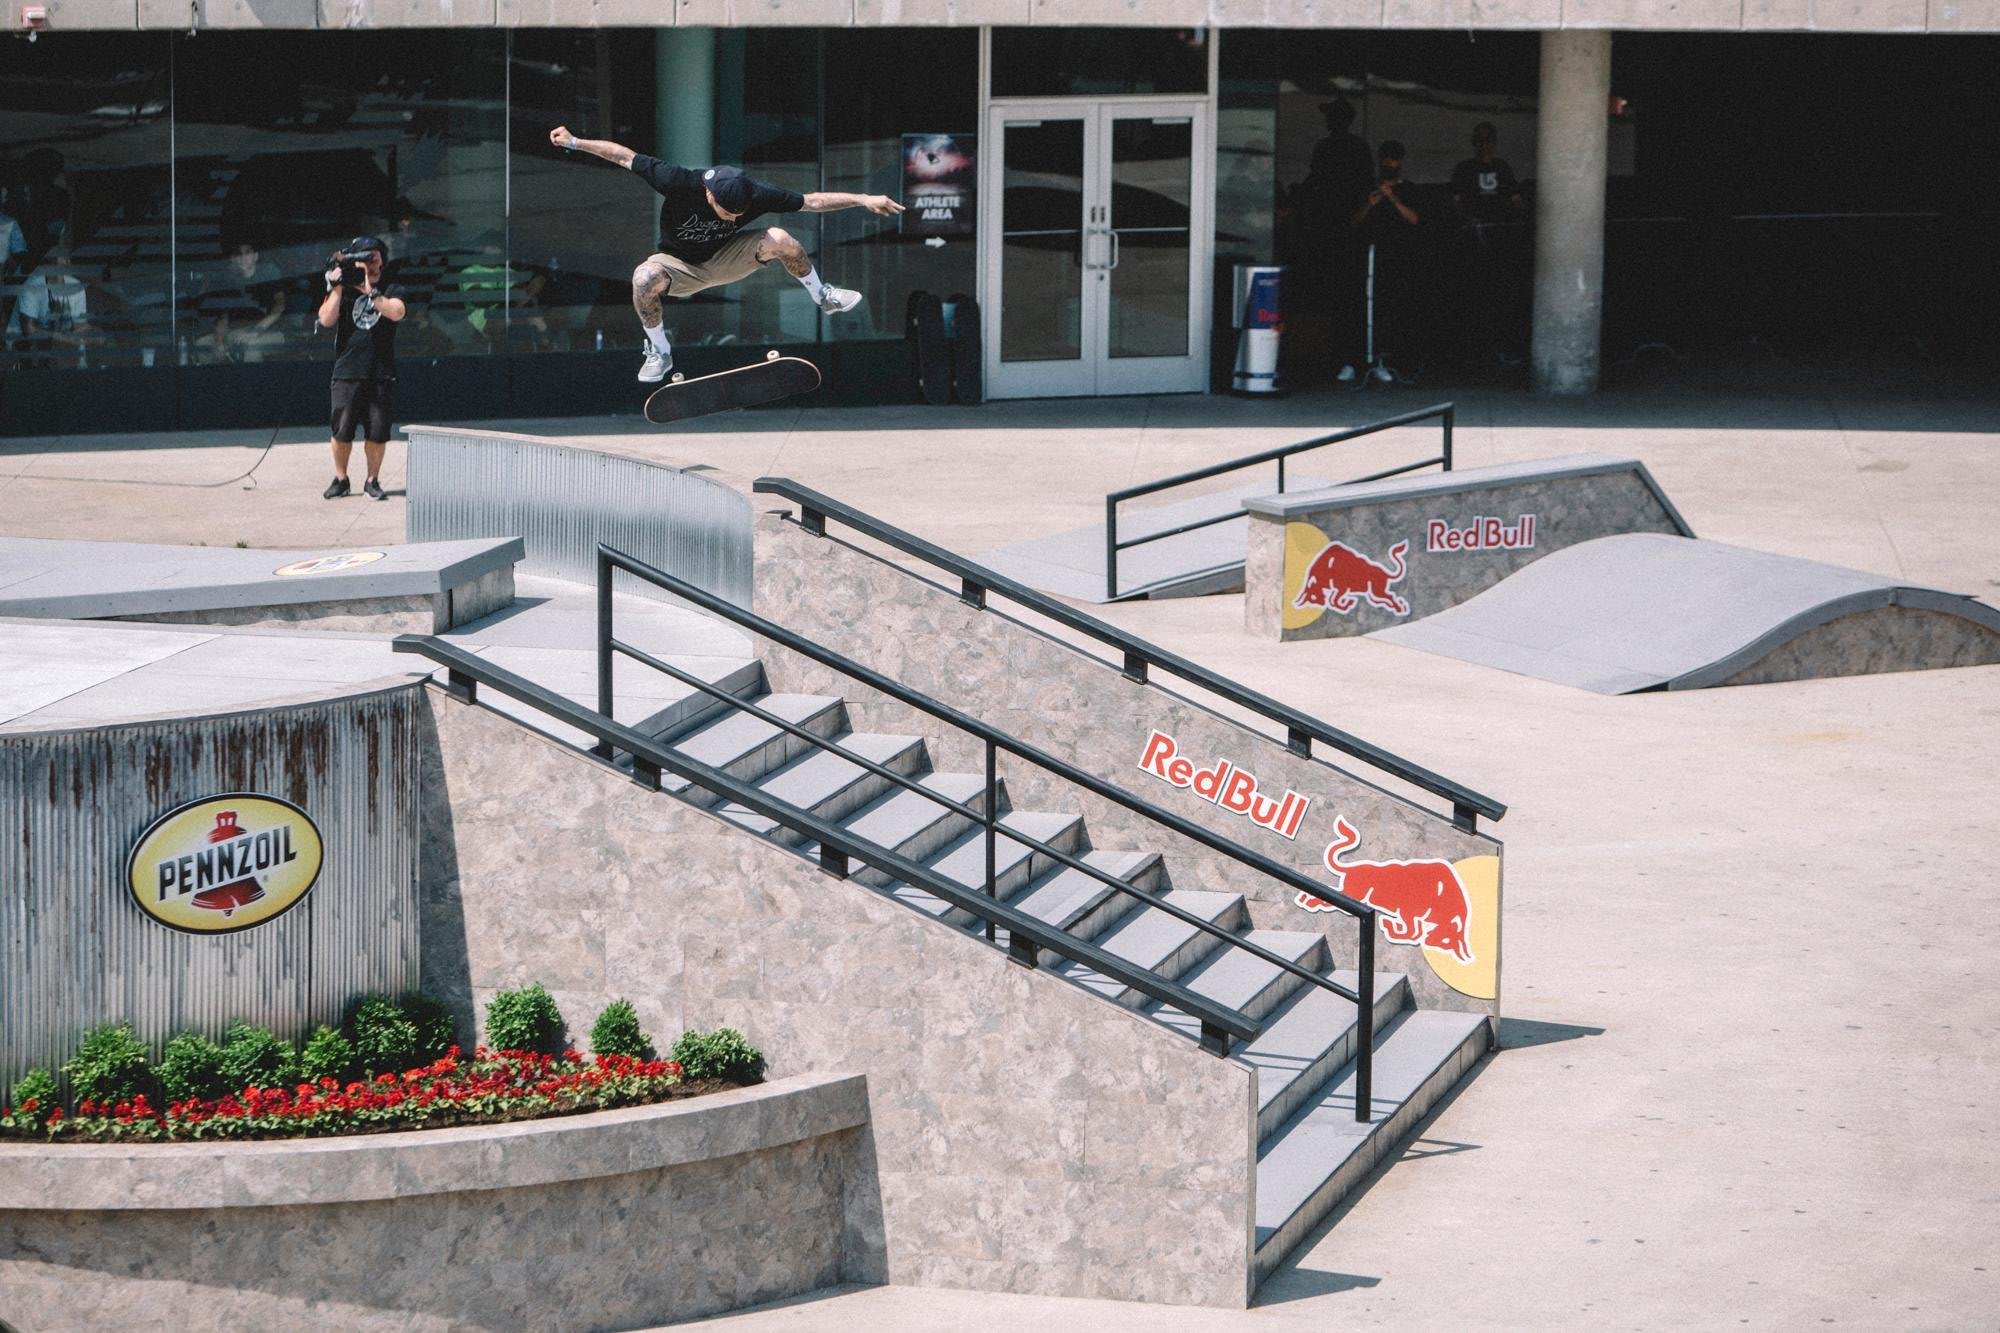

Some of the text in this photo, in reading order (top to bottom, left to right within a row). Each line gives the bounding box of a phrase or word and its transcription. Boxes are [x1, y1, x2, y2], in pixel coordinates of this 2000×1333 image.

[915, 195, 960, 208] ATHLETE
[922, 208, 953, 220] AREA
[159, 825, 298, 902] PENNZOIL
